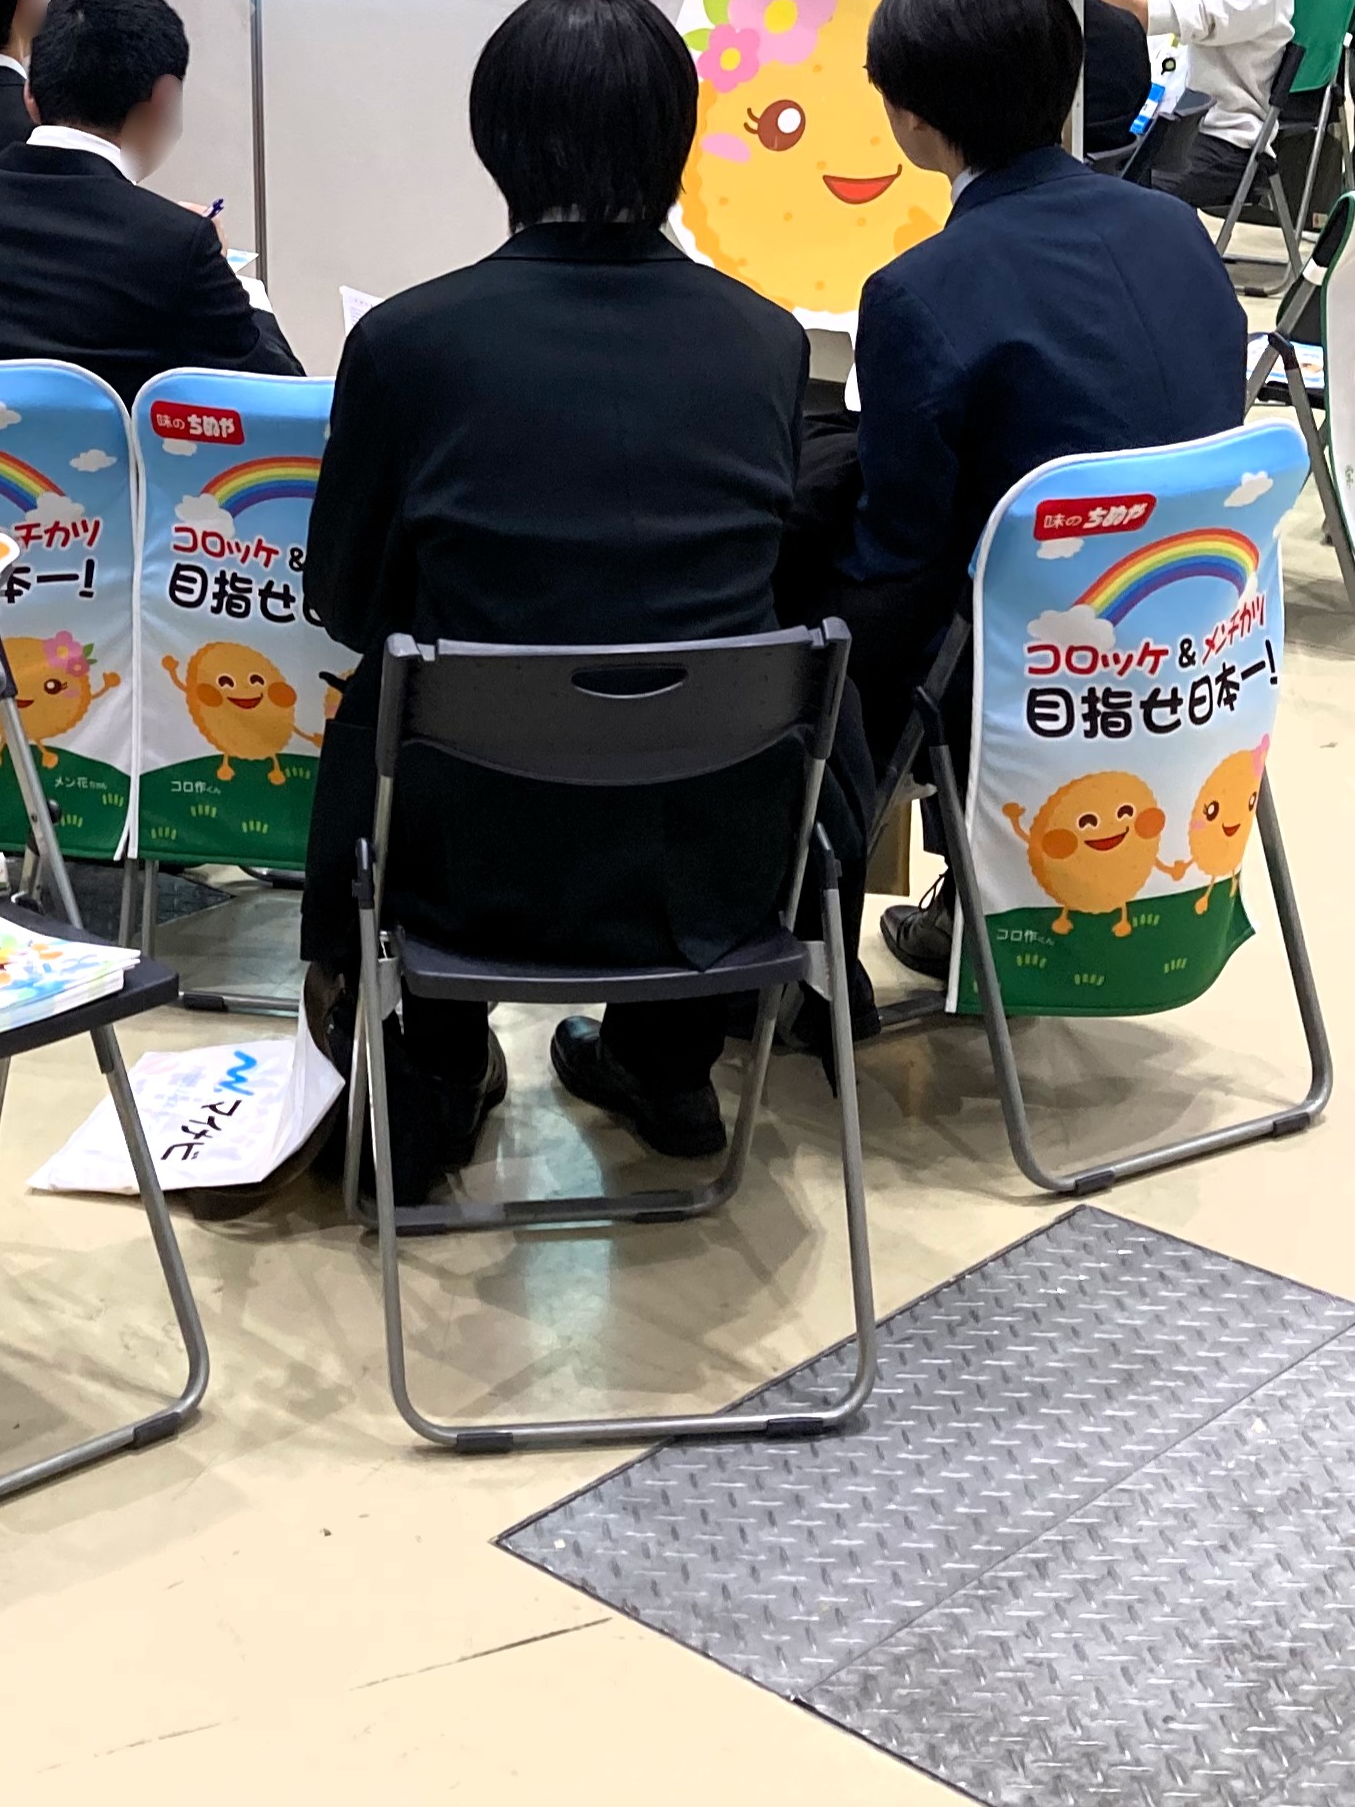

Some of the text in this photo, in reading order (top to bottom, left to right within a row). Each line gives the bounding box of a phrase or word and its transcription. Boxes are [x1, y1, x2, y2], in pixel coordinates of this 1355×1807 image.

[156, 414, 235, 438] 味のちぬや
[1044, 502, 1148, 530] 味のちぬや
[173, 526, 279, 568] コロッケ
[169, 563, 326, 628] 目指せ
[1027, 641, 1169, 677] コロッケ
[1202, 595, 1265, 665] メンチカツ
[1026, 639, 1278, 739] 目指せ日本一!
[171, 780, 222, 795] コロ作くん
[160, 1100, 242, 1161] マイナビ
